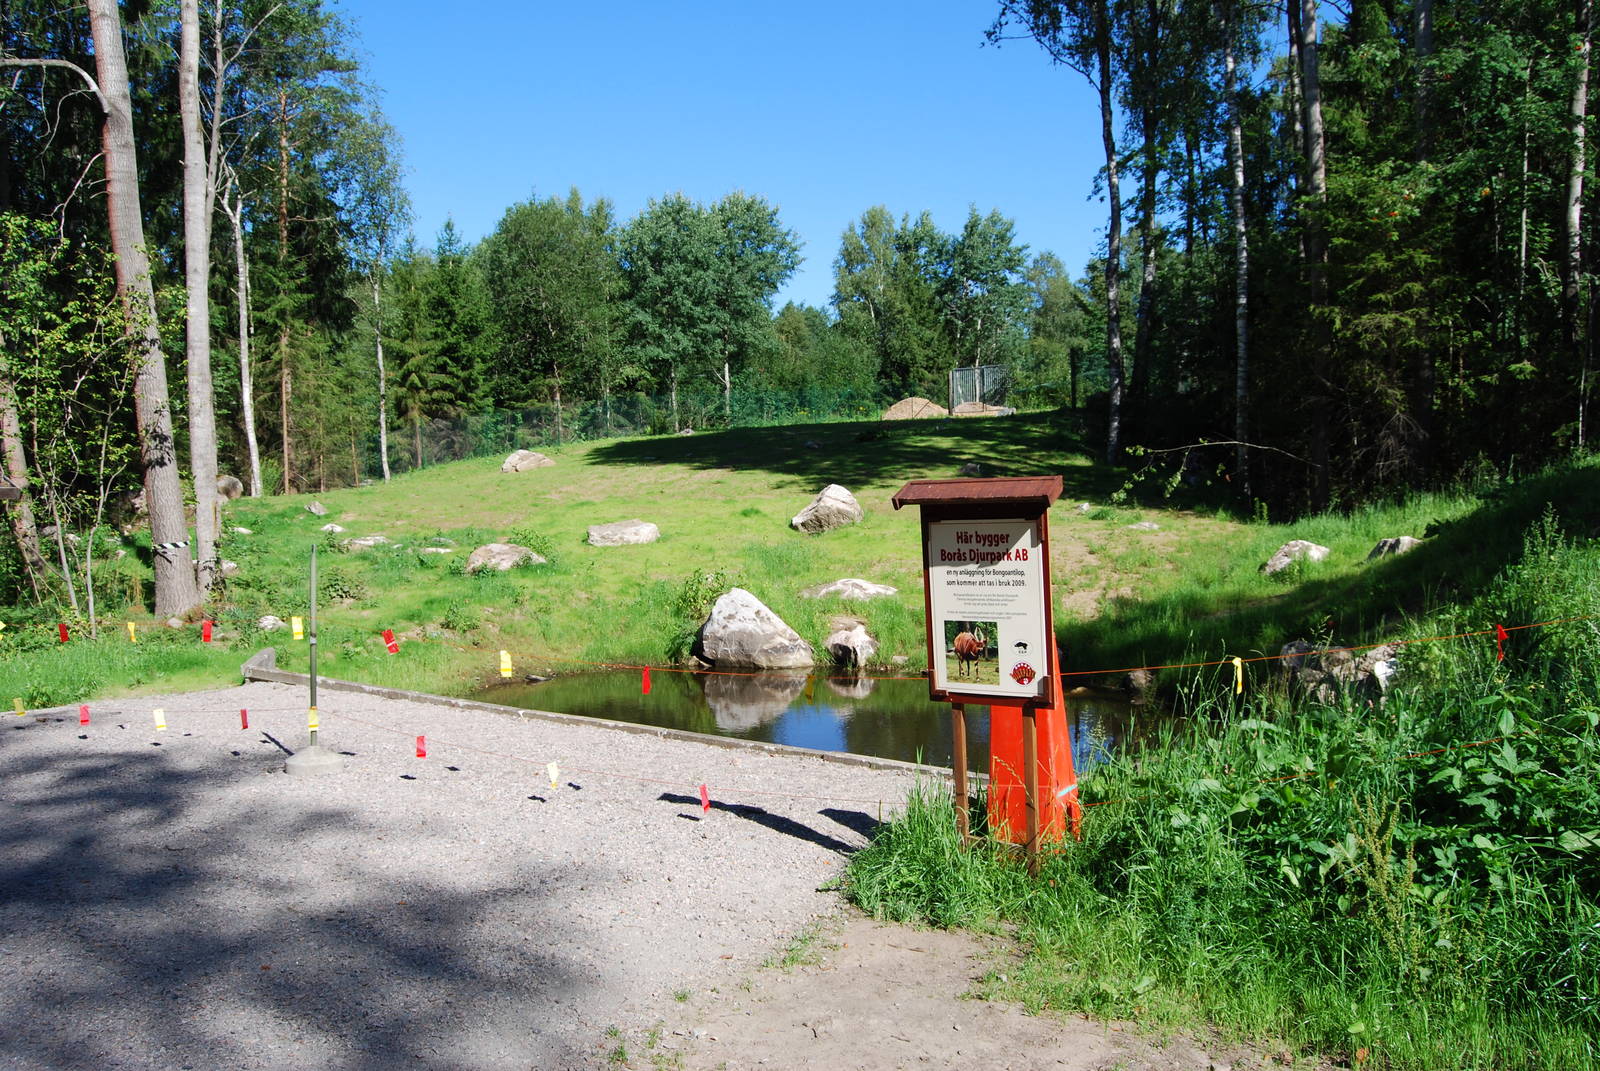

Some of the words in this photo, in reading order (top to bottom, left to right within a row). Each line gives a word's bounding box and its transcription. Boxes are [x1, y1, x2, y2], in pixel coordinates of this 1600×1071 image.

[956, 531, 973, 544] Här
[975, 531, 1010, 547] bygger
[940, 548, 967, 561] Borås
[969, 548, 1012, 564] Djurpark
[1014, 548, 1028, 561] AB
[959, 569, 984, 577] anläggning
[992, 569, 1025, 578] Bongoantilop,
[1012, 579, 1026, 587] 2009.
